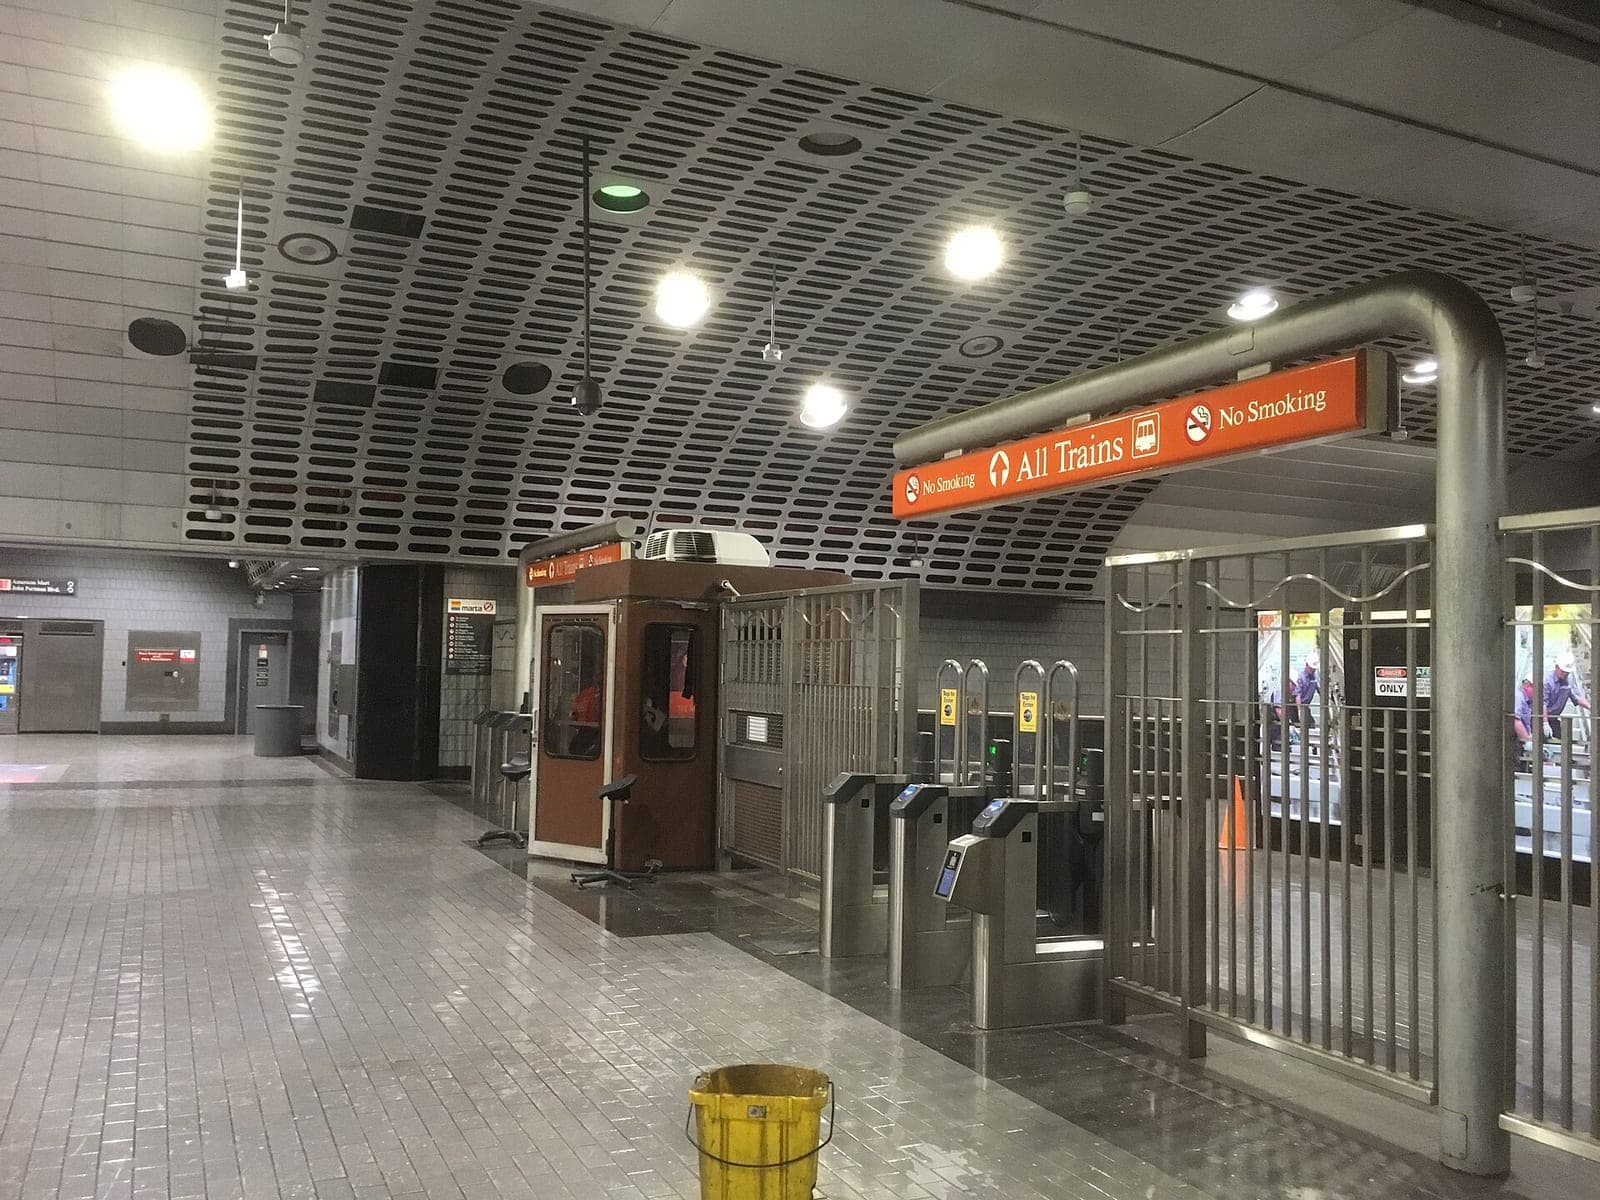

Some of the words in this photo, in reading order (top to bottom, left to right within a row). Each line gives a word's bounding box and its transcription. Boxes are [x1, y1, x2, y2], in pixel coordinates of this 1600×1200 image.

[1219, 407, 1244, 429] No
[1247, 389, 1327, 423] Smoking
[1016, 446, 1048, 482] All
[1054, 434, 1124, 474] Trains
[922, 480, 936, 496] No
[936, 473, 976, 493] Smoking
[1379, 684, 1404, 693] ONLY
